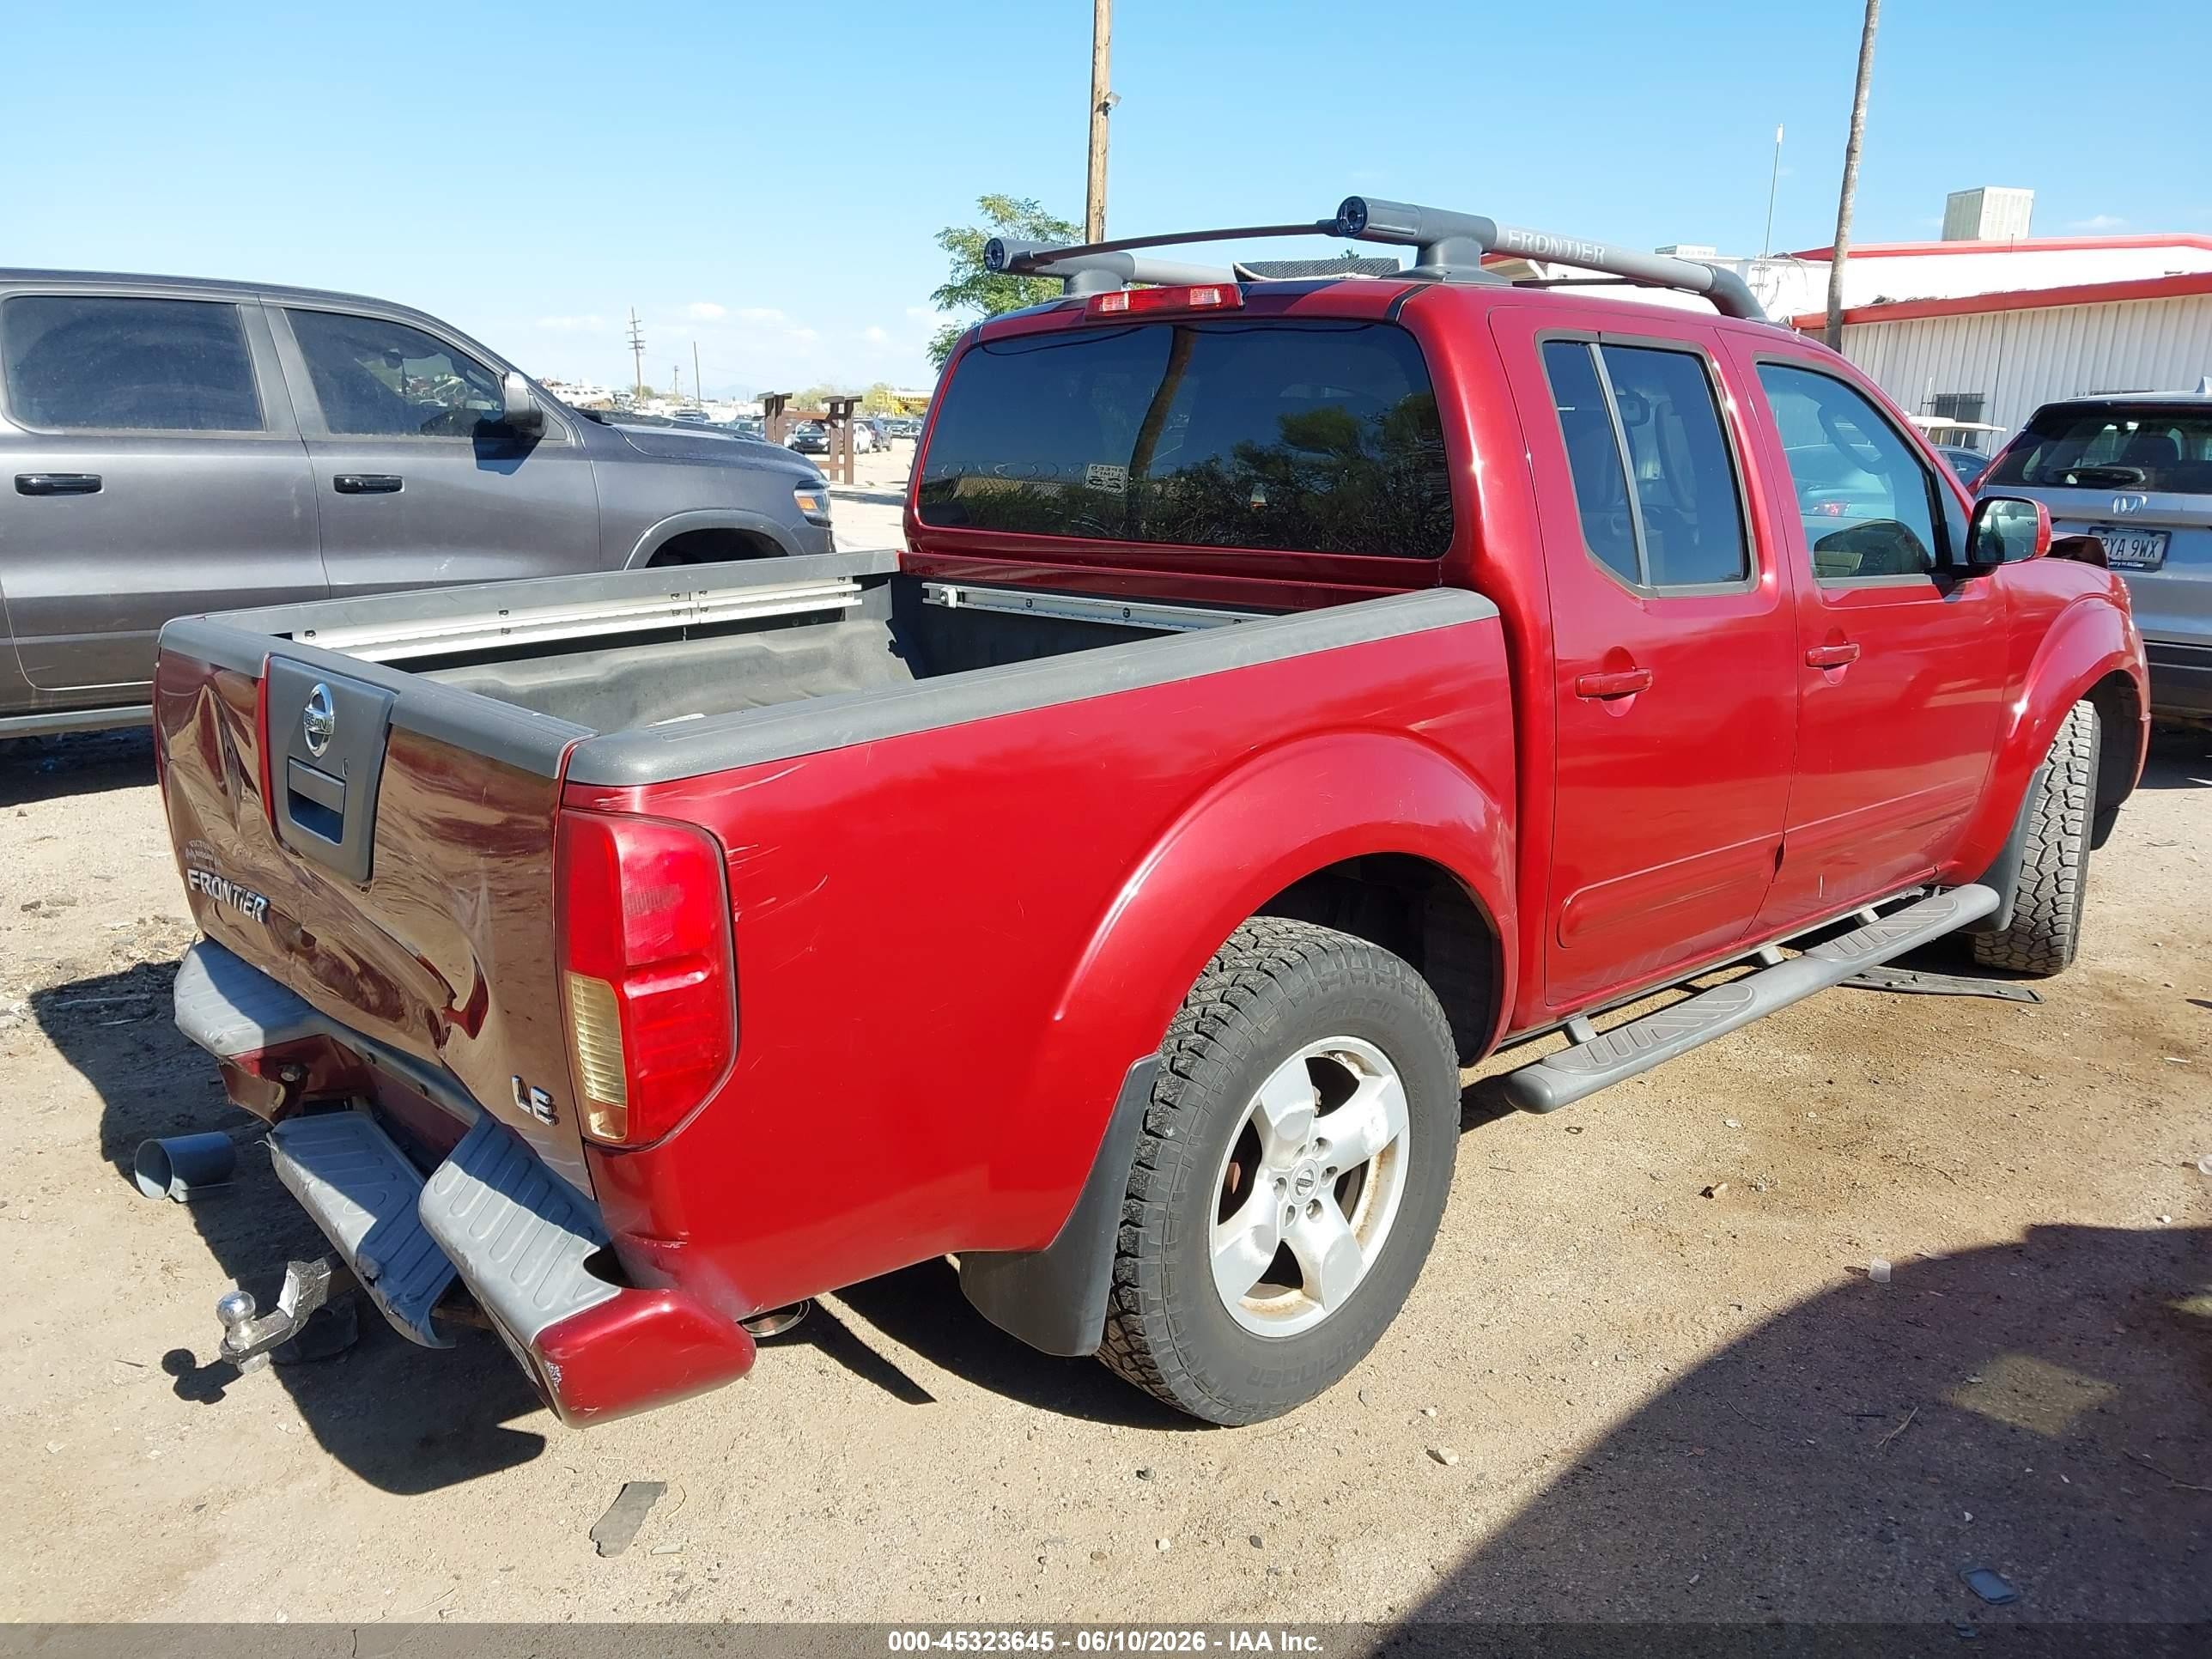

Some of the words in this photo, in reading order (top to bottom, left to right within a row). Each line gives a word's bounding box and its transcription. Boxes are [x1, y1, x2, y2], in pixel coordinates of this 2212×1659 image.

[1506, 229, 1606, 264] FRONTIER
[2130, 539, 2159, 558] 9WX
[187, 868, 269, 925] FRONTIER
[512, 1075, 556, 1127] LE
